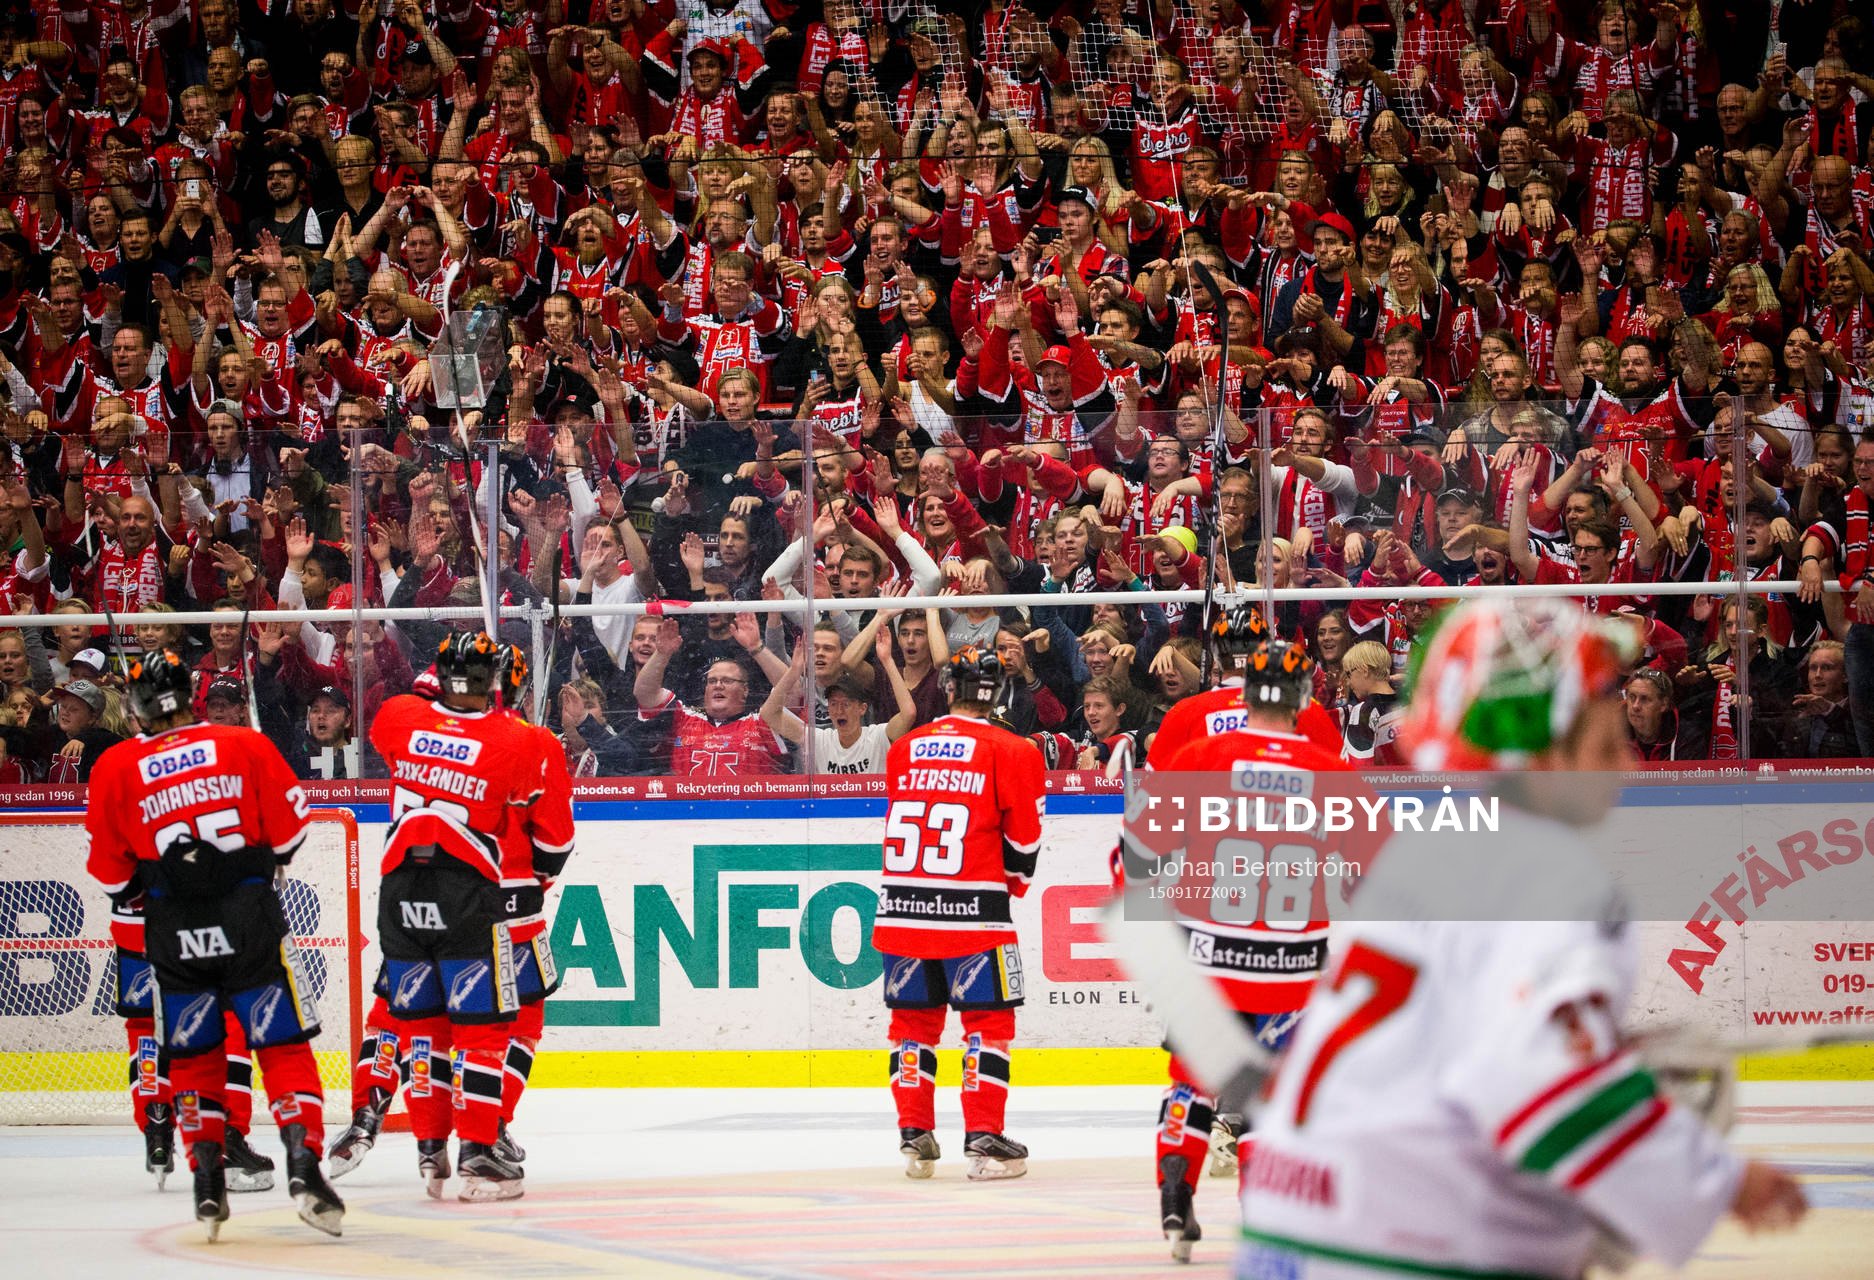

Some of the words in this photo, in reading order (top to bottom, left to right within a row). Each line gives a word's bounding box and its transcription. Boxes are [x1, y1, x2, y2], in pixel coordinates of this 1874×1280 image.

[1213, 712, 1248, 733] ÖBA
[415, 732, 470, 761] ÖBAB
[914, 738, 966, 758] ÖBAB
[148, 745, 207, 778] ÖBAB
[1622, 768, 1679, 781] emanning
[1682, 767, 1715, 778] sedan
[1719, 767, 1748, 778] 1996
[573, 785, 635, 795] nboden.se
[676, 782, 740, 795] Rekrytering
[743, 782, 763, 793] och
[766, 781, 827, 794] bemanning
[830, 781, 862, 792] sedan
[866, 781, 887, 791] 199
[1240, 762, 1303, 794] ÖBAB
[15, 791, 45, 801] sedan
[49, 791, 75, 801] 1996
[303, 787, 329, 800] ering
[332, 786, 351, 797] och
[354, 786, 389, 797] beman
[884, 800, 970, 876] 53
[1210, 838, 1318, 931] 88
[400, 901, 448, 931] NA
[176, 926, 235, 960] NA
[1193, 933, 1318, 969] Katrinelund
[1050, 992, 1101, 1005] ELON
[140, 1038, 157, 1093] ELON
[412, 1038, 430, 1095] ELON
